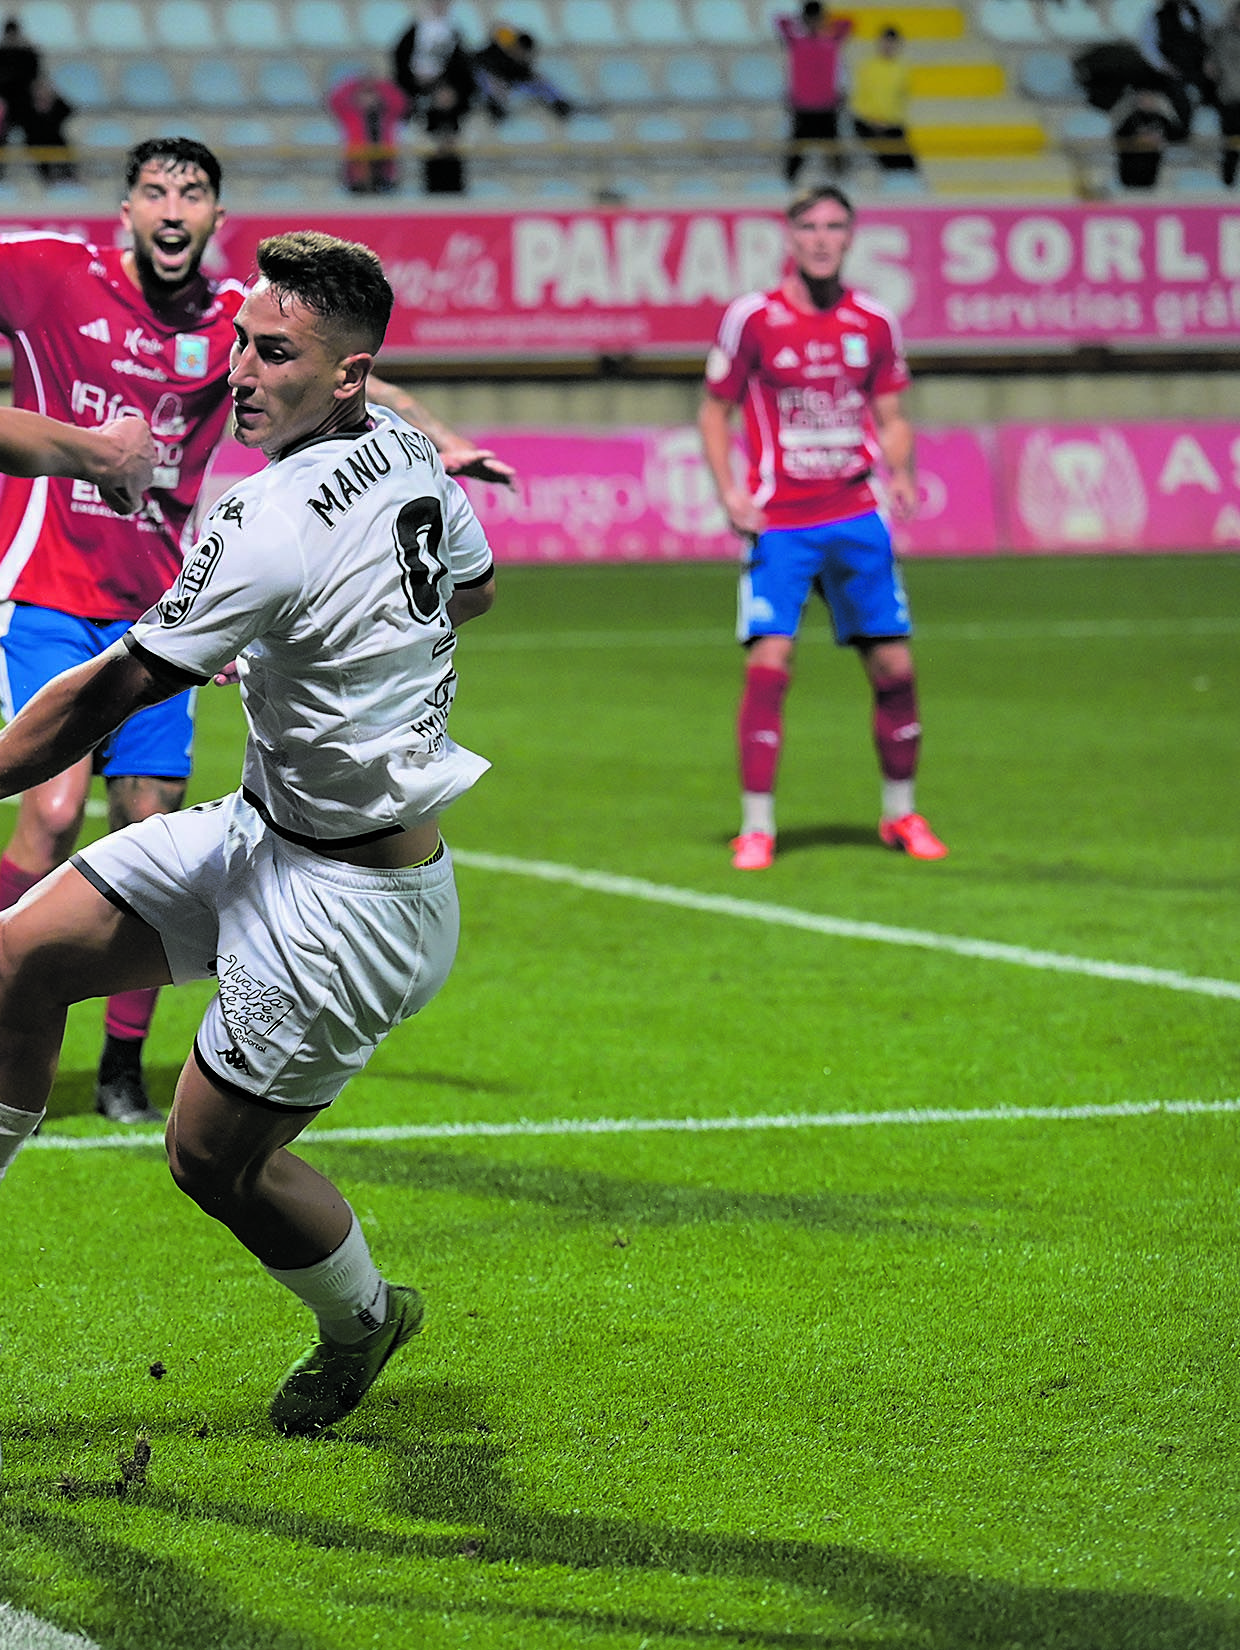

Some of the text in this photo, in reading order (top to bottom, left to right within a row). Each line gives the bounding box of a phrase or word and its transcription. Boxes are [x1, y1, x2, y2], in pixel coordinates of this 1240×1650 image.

[308, 437, 392, 530] MANU
[261, 985, 284, 1009] la
[241, 1003, 274, 1024] nos
[232, 1027, 268, 1054] Soportal
